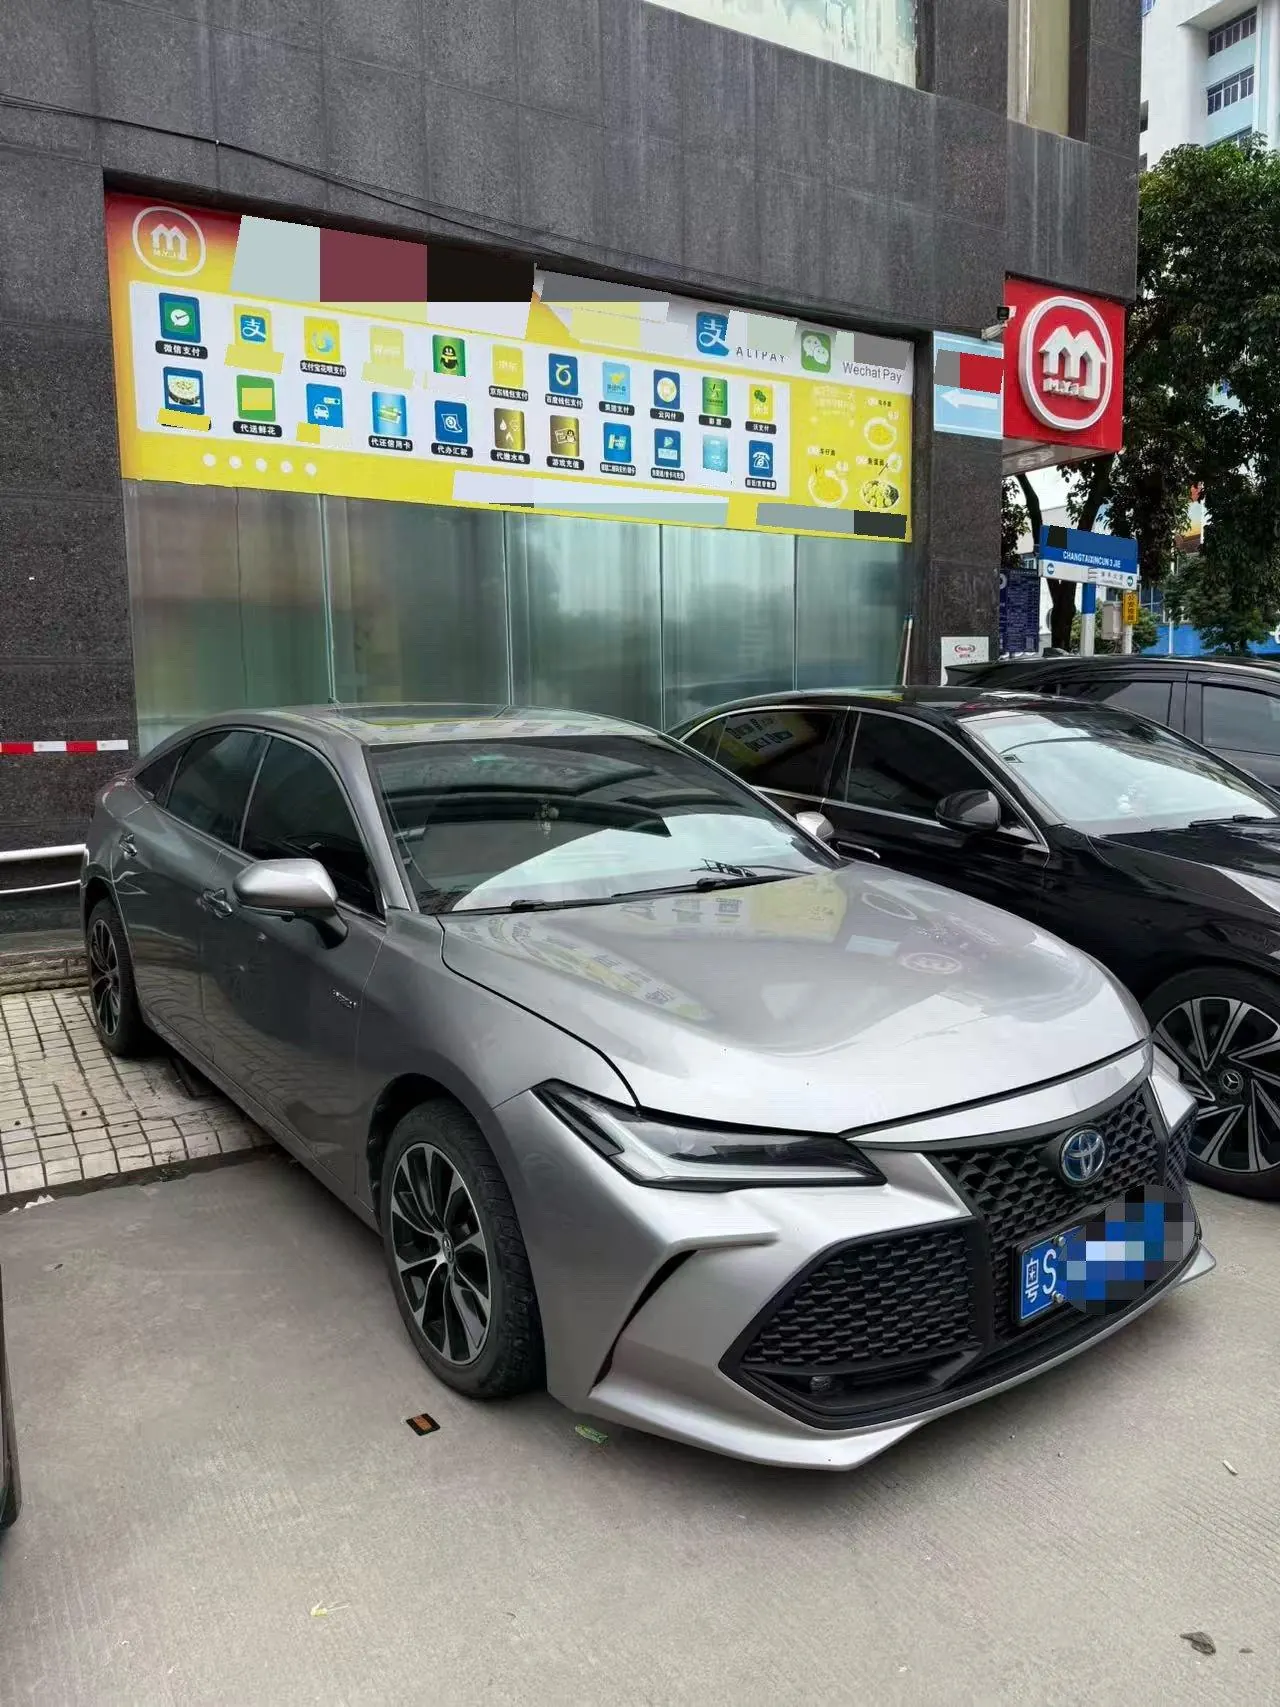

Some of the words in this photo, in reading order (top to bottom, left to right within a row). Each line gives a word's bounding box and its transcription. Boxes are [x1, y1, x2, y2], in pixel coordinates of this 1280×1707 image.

[163, 343, 200, 357] 微信支付
[736, 346, 786, 363] ALIPAY
[843, 361, 881, 379] Wechat
[883, 370, 903, 385] Pay
[659, 411, 677, 420] 云闪付
[240, 424, 276, 436] 代送鲜花
[1113, 559, 1121, 568] JIE
